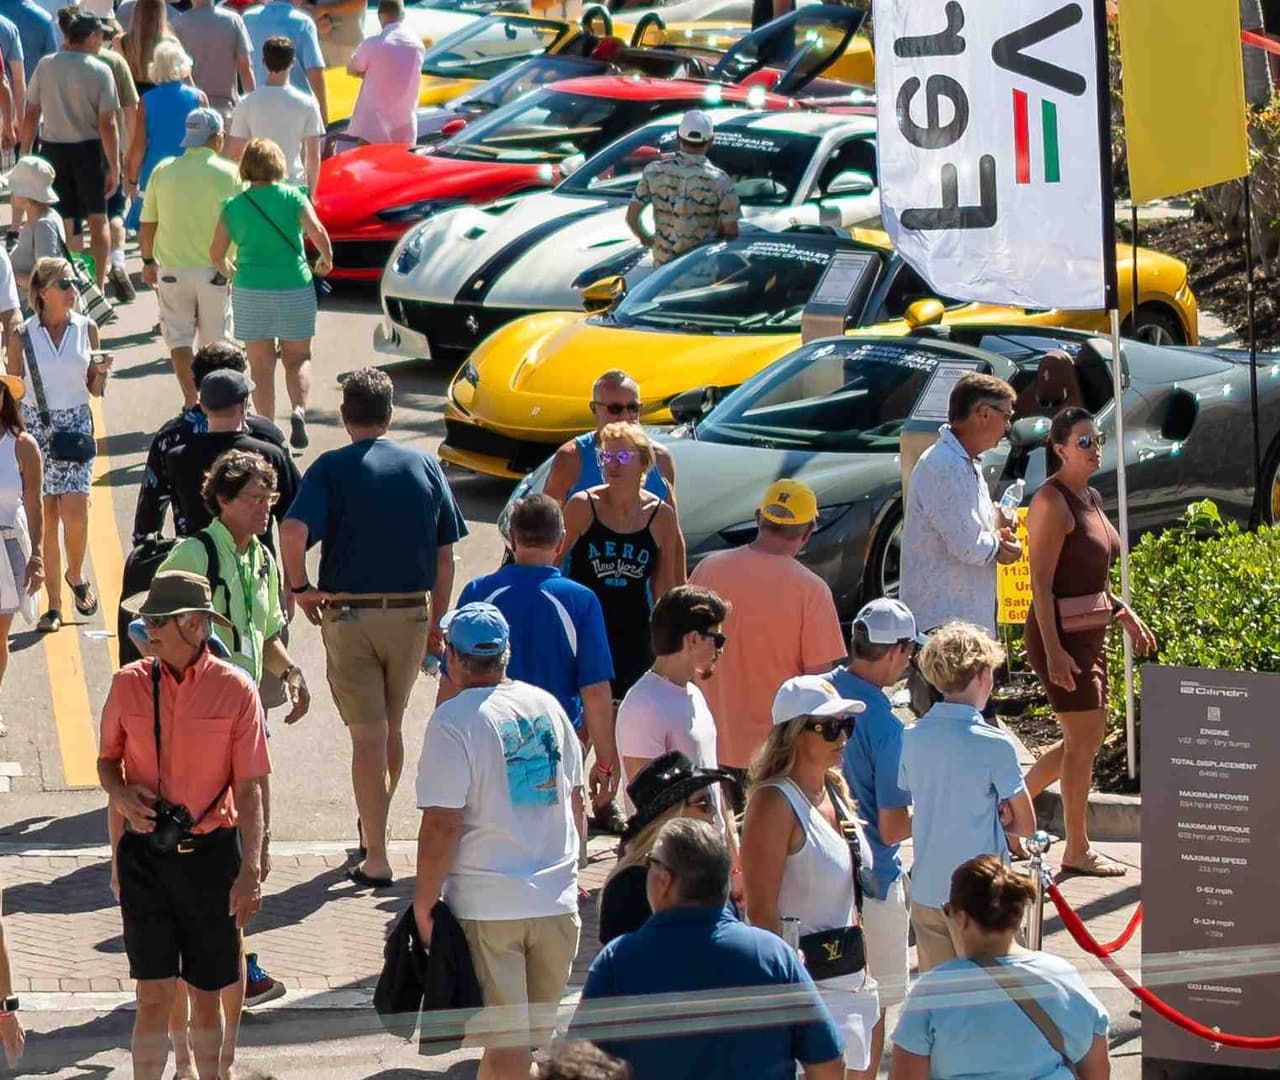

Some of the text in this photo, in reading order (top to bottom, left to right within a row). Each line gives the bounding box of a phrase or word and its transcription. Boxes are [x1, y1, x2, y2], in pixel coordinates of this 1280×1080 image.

[588, 541, 650, 564] AERO
[1002, 566, 1029, 577] 11:3
[1199, 727, 1231, 737] ENGINE
[1170, 758, 1259, 771] TOTAL DISPLACEMENT
[1178, 790, 1250, 802] MAXIMUM POWER
[1177, 822, 1251, 834] MAXIMUM TORQUE
[1180, 853, 1248, 865] MAXIMUM SPEED
